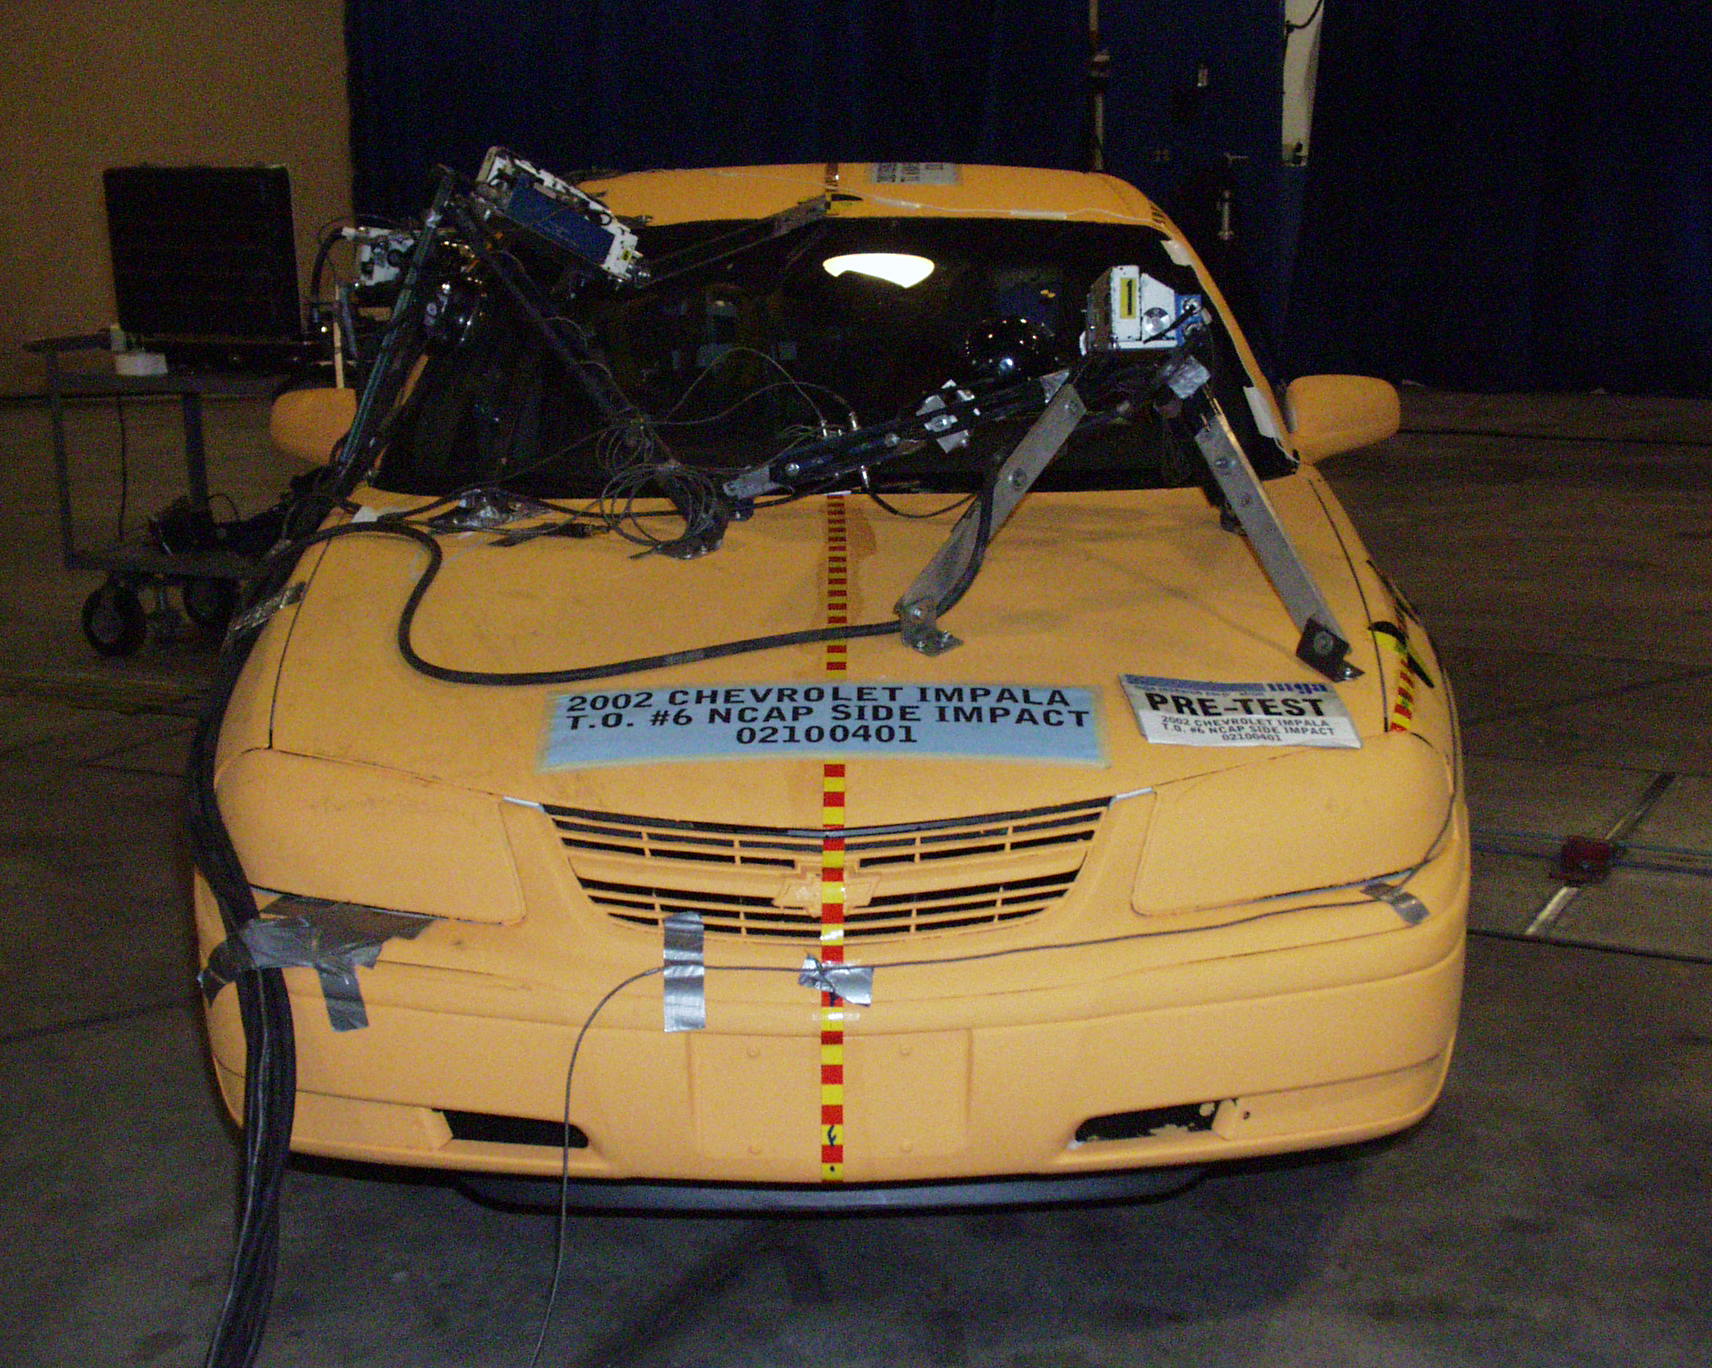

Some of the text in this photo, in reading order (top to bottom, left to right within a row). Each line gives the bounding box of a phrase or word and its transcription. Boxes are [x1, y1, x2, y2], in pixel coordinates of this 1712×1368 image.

[566, 686, 1071, 712] 2002 CHEVROLET IMPALA
[1144, 692, 1325, 717] PRE-TEST
[566, 703, 1090, 730] T.O. #6 NCAP SIDE IMPACT
[1160, 715, 1330, 728] 2002 CHEVROLET IMPALA
[735, 724, 918, 745] 02100401
[1208, 725, 1245, 735] NCAP
[1248, 725, 1282, 735] SIDE
[1284, 726, 1336, 737] IMPACT
